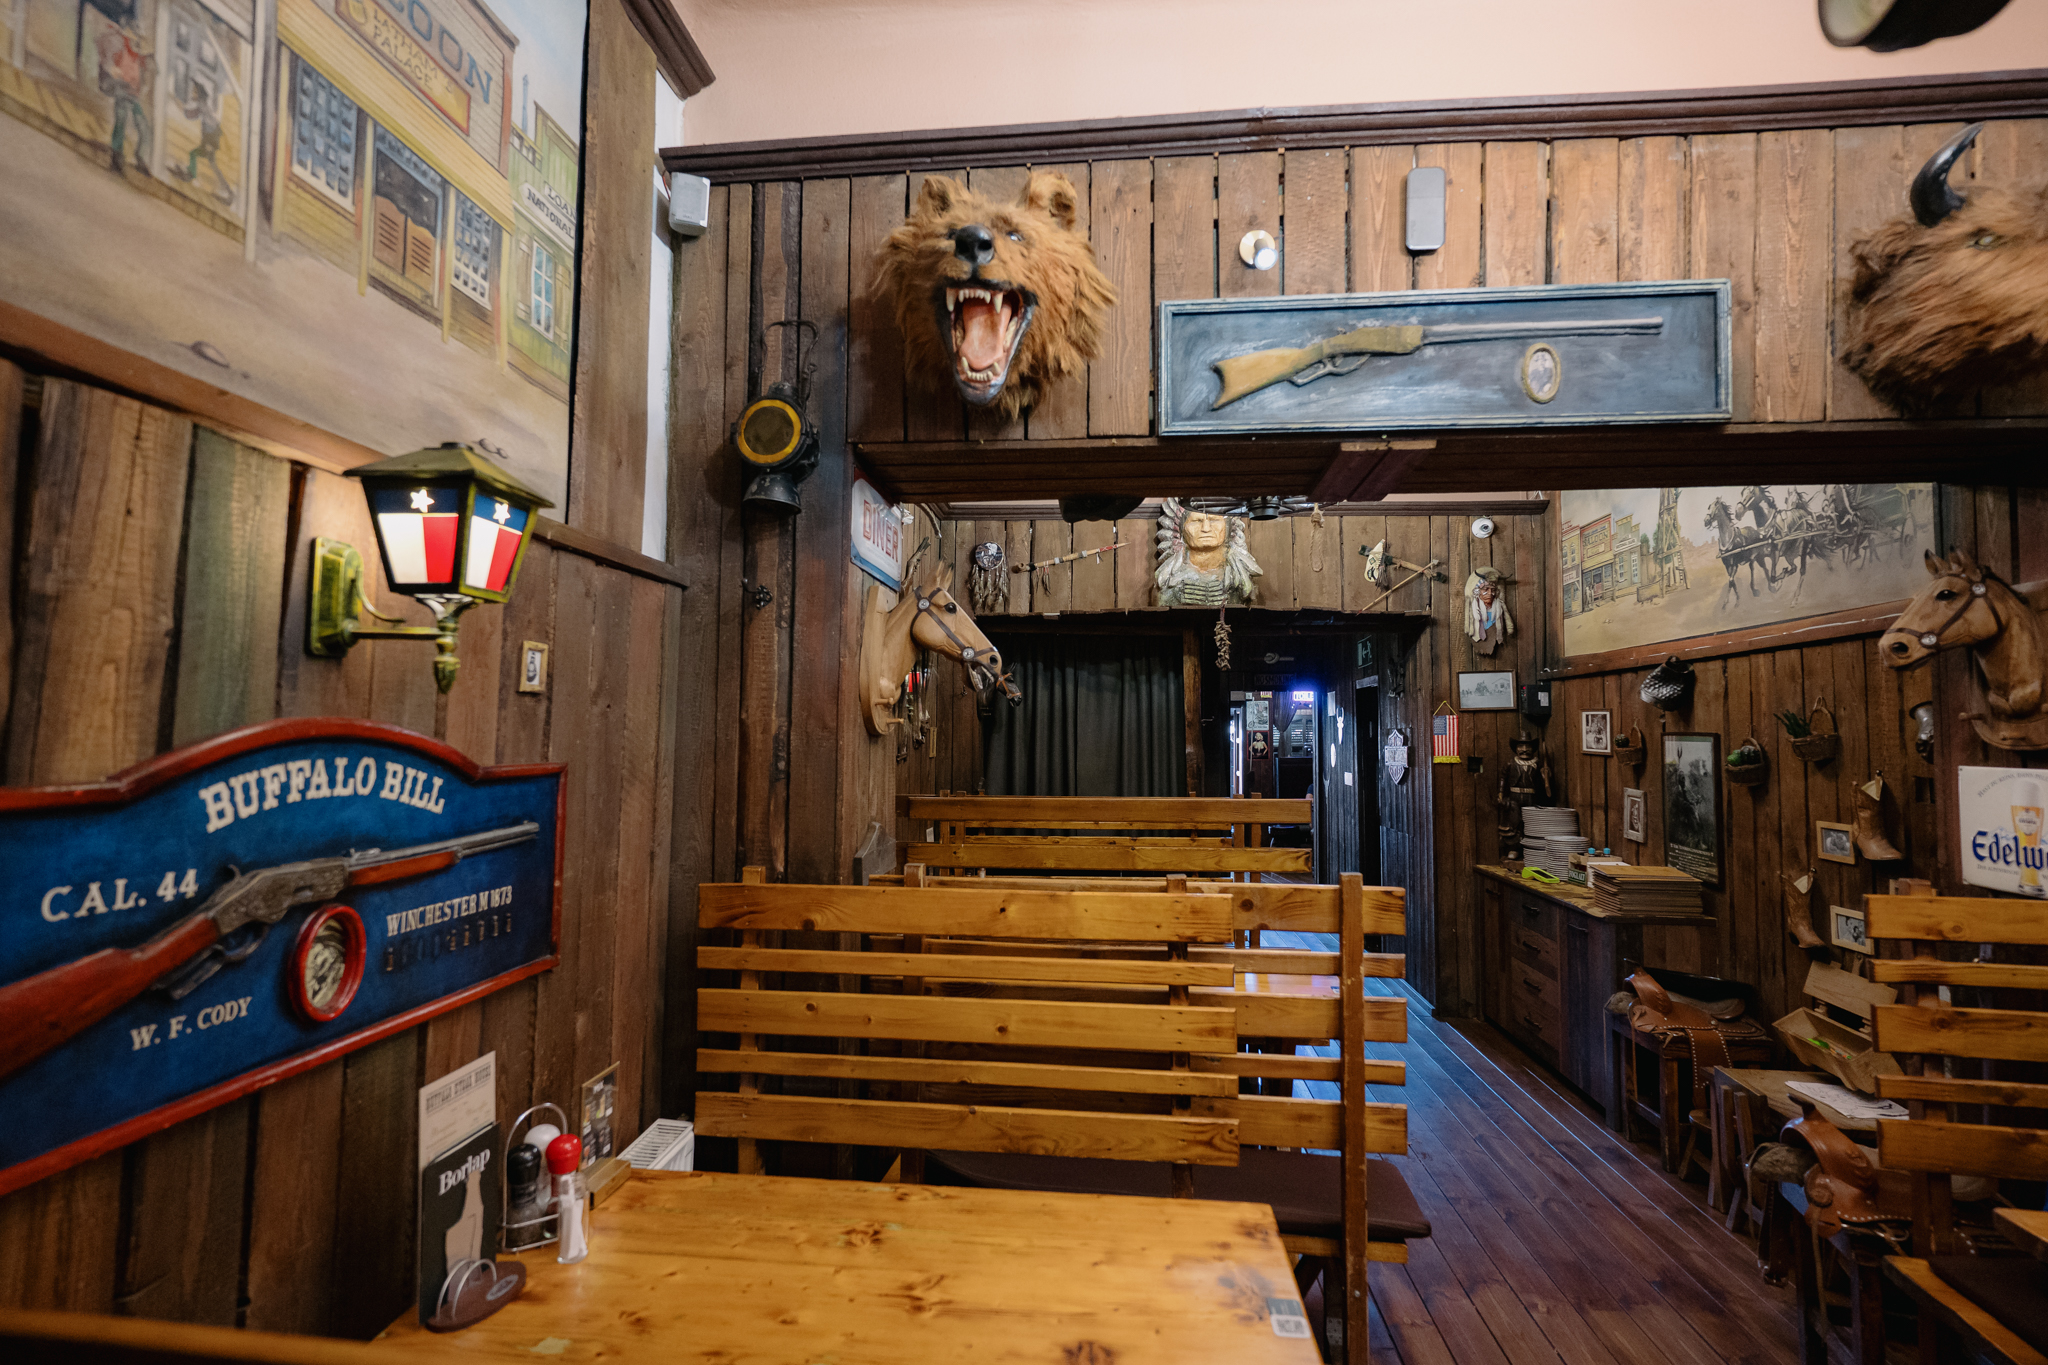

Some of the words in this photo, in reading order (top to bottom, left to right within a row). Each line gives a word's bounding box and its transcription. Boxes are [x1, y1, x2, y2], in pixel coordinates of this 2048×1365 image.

[373, 25, 433, 91] PALACE
[388, 0, 493, 105] OON
[527, 187, 574, 240] NATIONAL
[863, 499, 899, 563] DINER
[198, 756, 377, 834] BUFFALO
[379, 761, 445, 814] BILL
[41, 878, 147, 922] CAL.
[156, 868, 199, 902] 44
[386, 893, 478, 937] WINCHESTER
[490, 885, 513, 908] 1873
[130, 1023, 161, 1051] W.
[168, 1014, 192, 1040] F.
[197, 995, 253, 1030] CODY
[438, 1148, 491, 1197] Borlap
